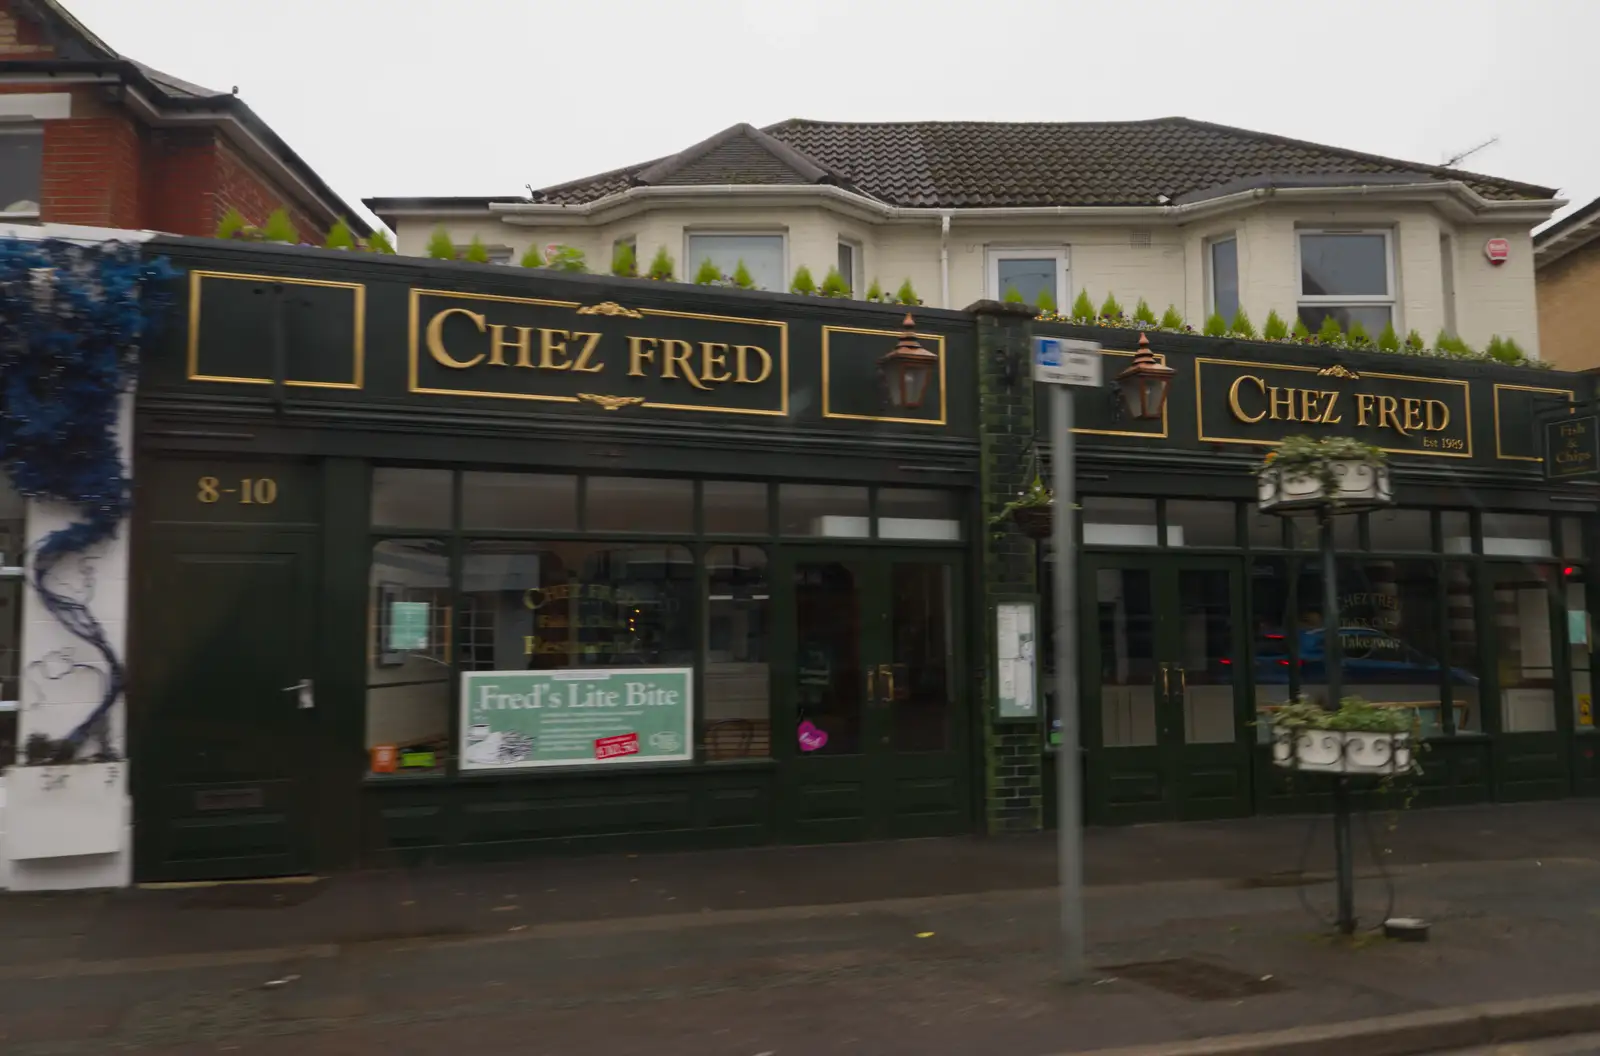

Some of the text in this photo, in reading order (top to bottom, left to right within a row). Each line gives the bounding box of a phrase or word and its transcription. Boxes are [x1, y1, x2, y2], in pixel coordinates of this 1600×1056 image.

[425, 307, 774, 391] CHEZ FRED
[1228, 374, 1451, 438] CHEZ FRED
[477, 681, 679, 711] Fred's Lite Bite
